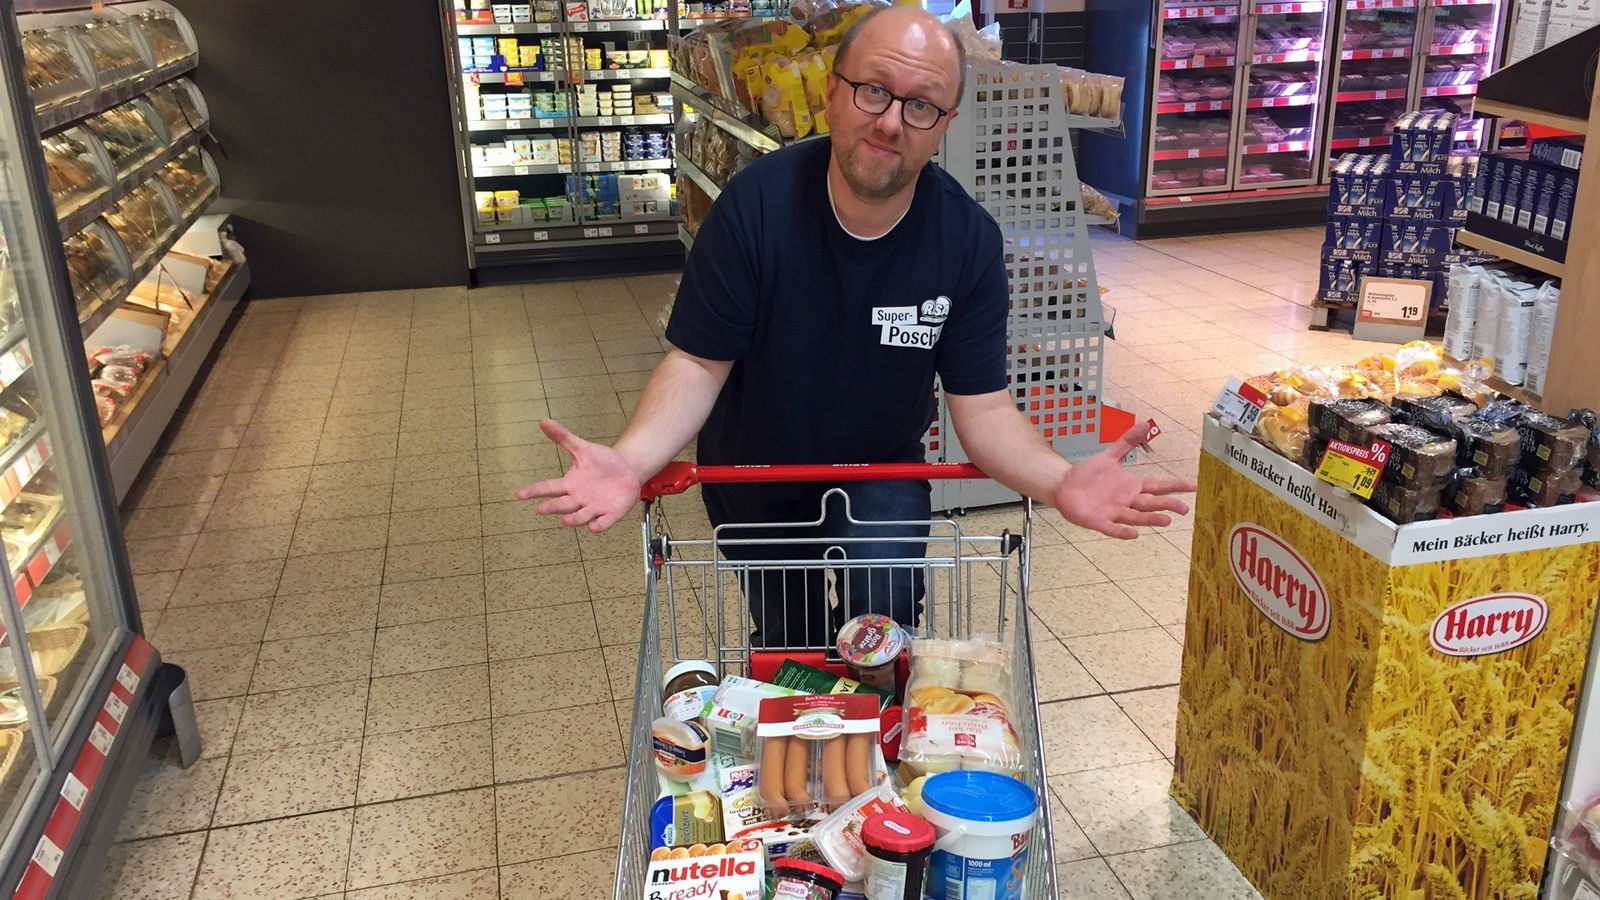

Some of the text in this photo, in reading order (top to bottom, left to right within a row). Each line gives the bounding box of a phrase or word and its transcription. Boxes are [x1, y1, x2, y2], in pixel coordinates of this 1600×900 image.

[1413, 211, 1434, 219] Milch
[877, 309, 913, 324] Super-
[1401, 306, 1418, 319] 1.19
[1328, 441, 1370, 459] AKTIONSPREIS
[1250, 456, 1286, 488] Bäcker
[1286, 474, 1317, 508] heißt
[1352, 473, 1373, 491] 1.09
[1412, 522, 1590, 553] Mein Bäcker heißt Harry.
[1239, 528, 1317, 630] Harry
[1443, 607, 1534, 642] Harry
[651, 858, 756, 883] nutella
[967, 860, 992, 868] 1000 ml
